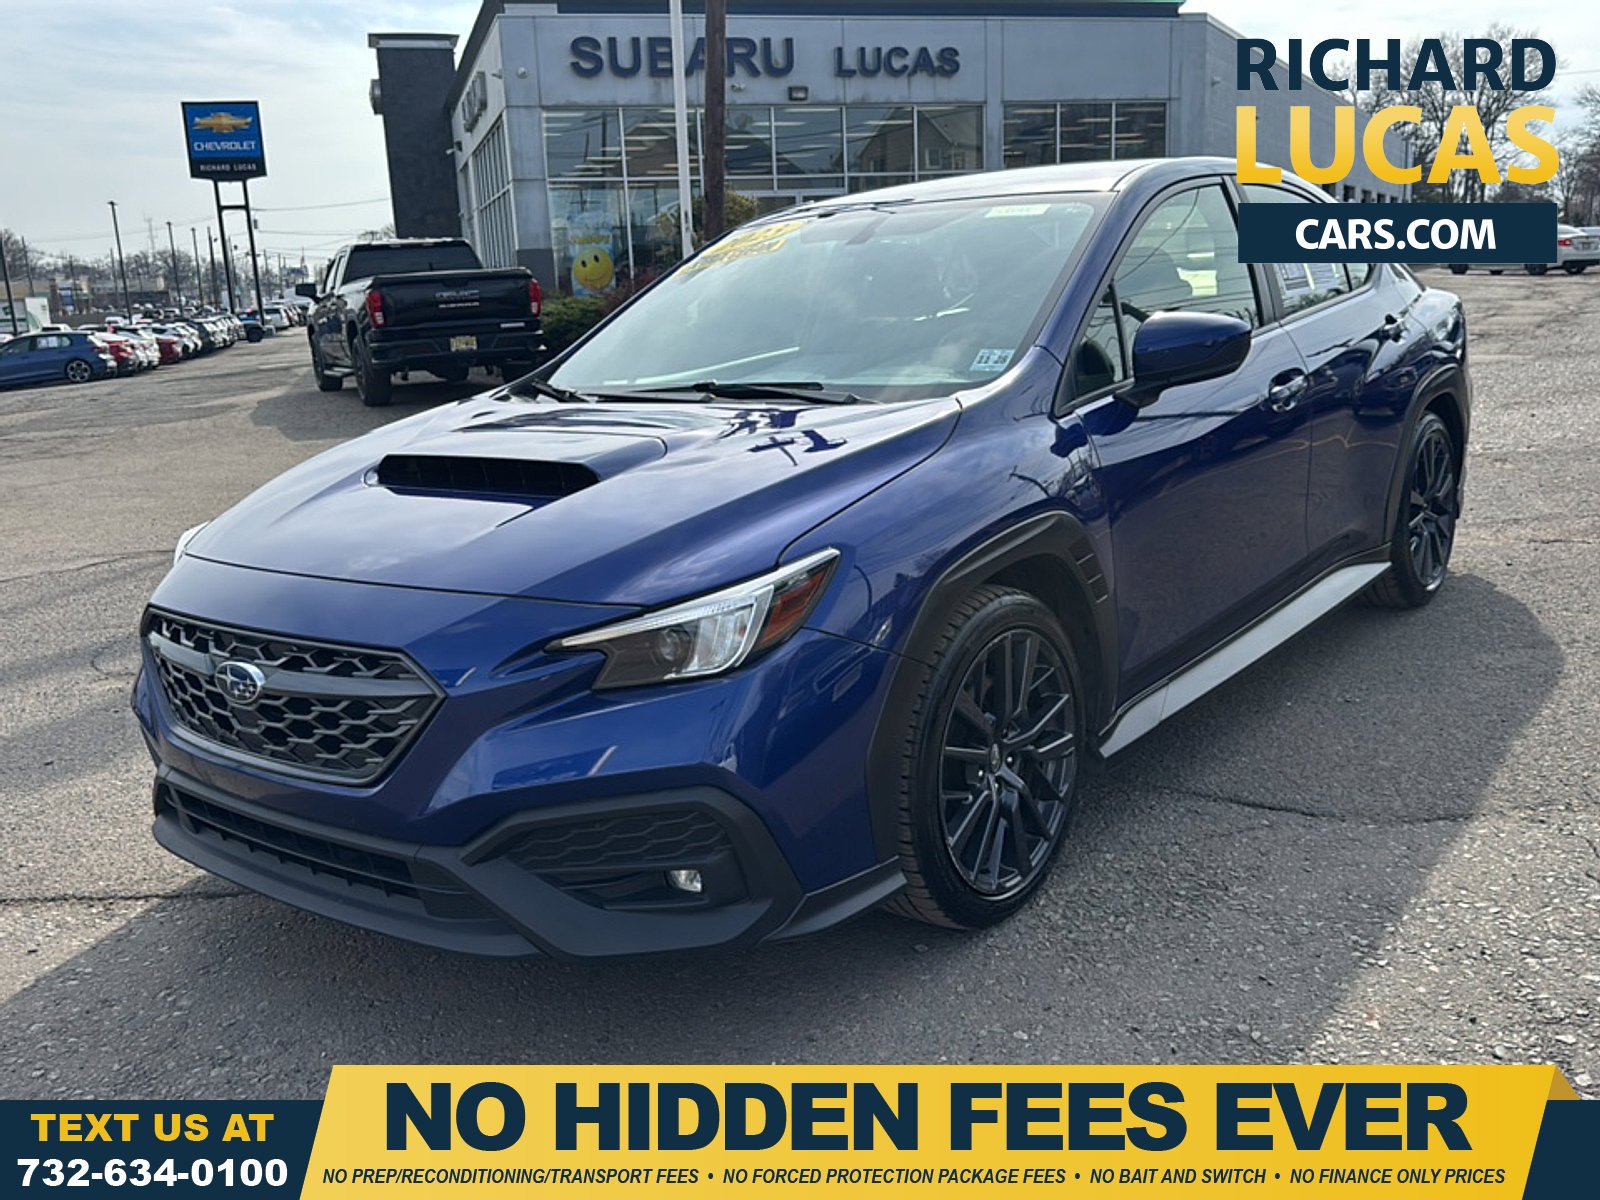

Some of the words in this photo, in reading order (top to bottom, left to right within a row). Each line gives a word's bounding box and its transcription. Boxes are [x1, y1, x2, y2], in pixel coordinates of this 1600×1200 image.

[834, 46, 961, 77] LUCAS
[193, 140, 256, 151] CHEVROLET
[200, 163, 231, 172] RICHARD
[233, 162, 257, 172] LUCAS
